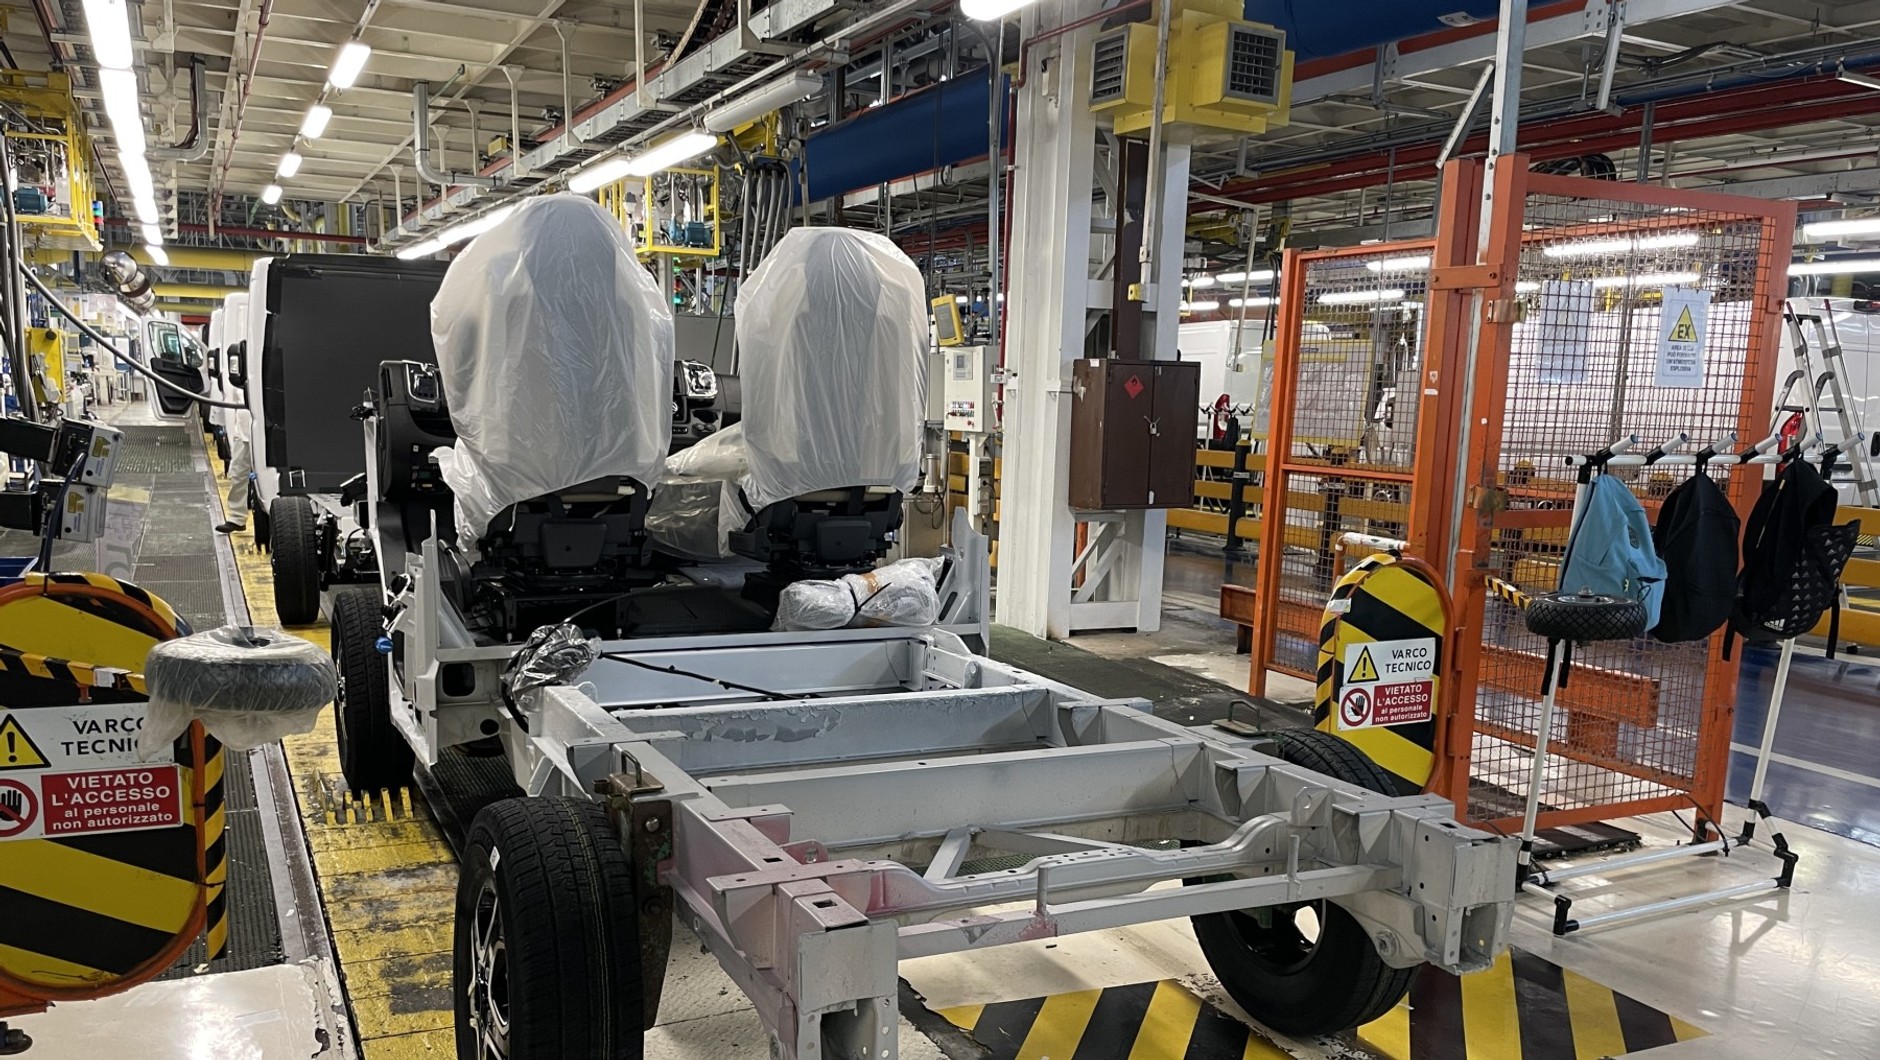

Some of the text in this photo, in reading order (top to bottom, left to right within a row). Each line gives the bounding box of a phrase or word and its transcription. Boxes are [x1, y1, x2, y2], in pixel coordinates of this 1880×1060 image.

[1678, 324, 1691, 339] EX
[1391, 647, 1427, 659] VARCO
[1385, 660, 1431, 673] TECNICO
[1384, 684, 1422, 695] VIETATO
[1376, 693, 1428, 706] L'ACCESSO
[1390, 704, 1423, 715] personale
[1390, 711, 1427, 721] autorizzato
[61, 738, 138, 755] TECNI
[67, 772, 153, 789] VIETATO
[52, 786, 170, 806] L'ACCESSO
[64, 802, 160, 818] al personale
[53, 813, 173, 830] non autorizzato
